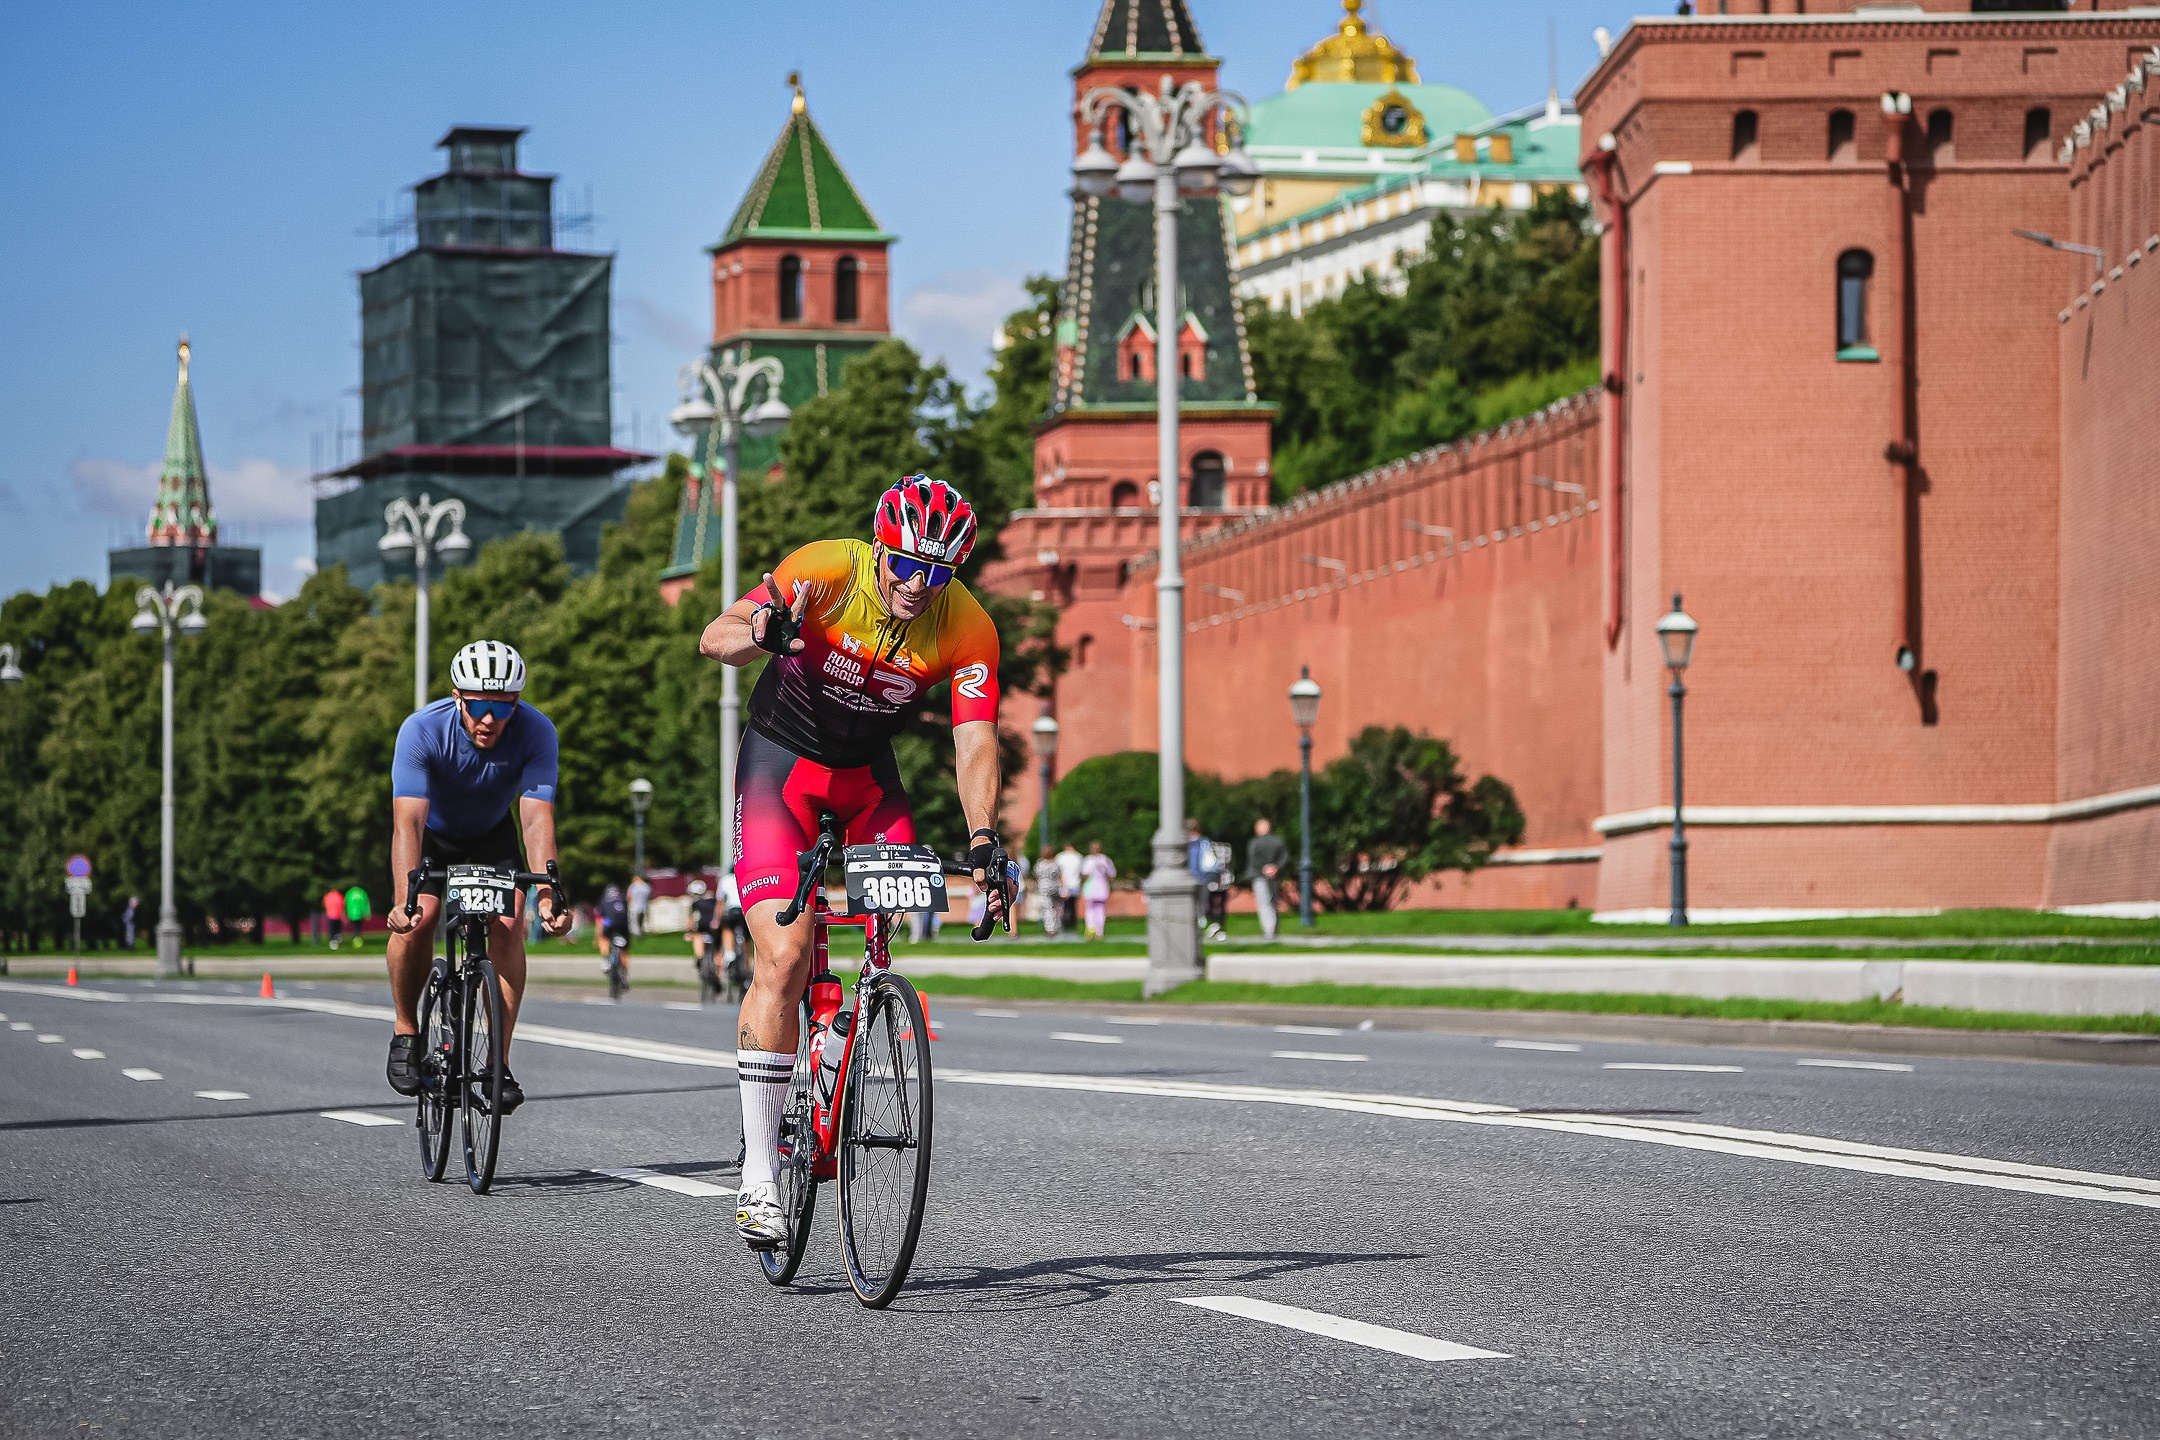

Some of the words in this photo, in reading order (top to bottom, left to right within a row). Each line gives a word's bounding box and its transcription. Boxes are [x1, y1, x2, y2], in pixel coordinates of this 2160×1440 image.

[918, 538, 945, 556] 3686
[822, 661, 865, 687] GROUP
[827, 650, 861, 674] ROAD
[460, 887, 505, 914] 3234
[863, 876, 932, 910] 3686
